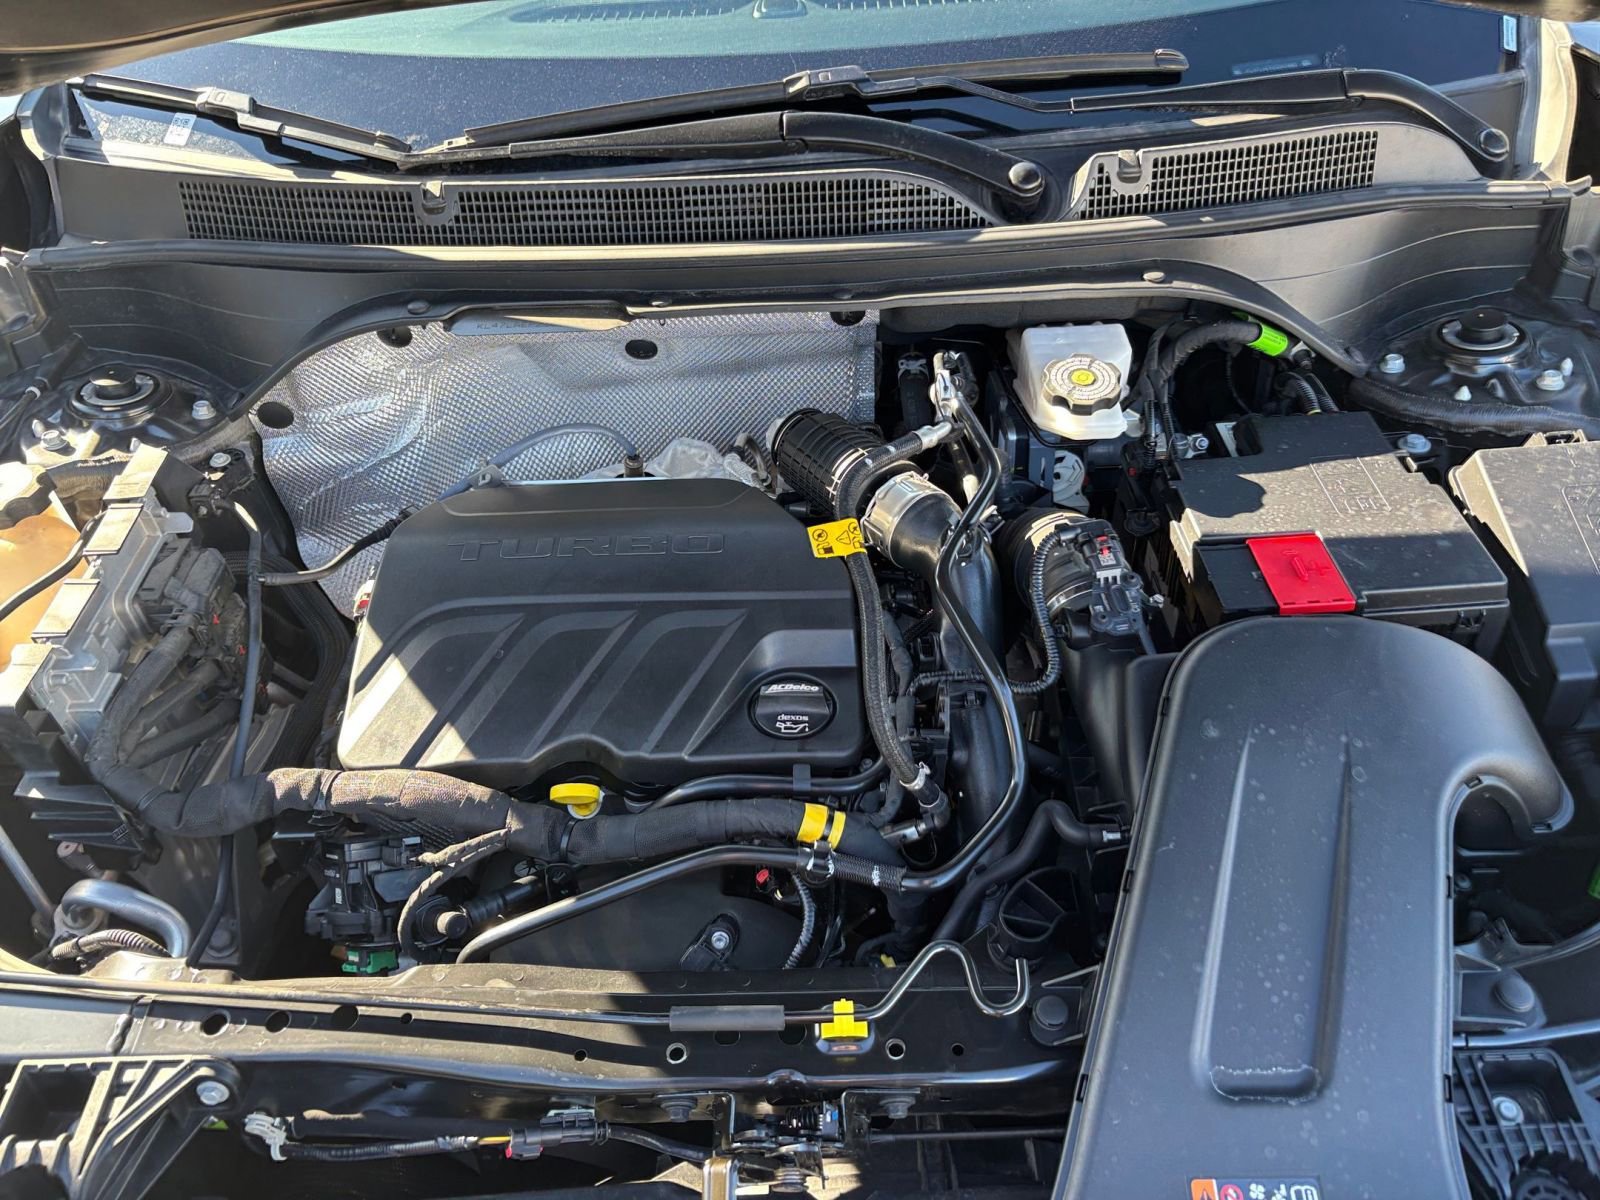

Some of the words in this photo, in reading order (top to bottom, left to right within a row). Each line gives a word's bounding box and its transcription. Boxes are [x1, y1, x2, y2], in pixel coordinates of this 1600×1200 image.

[448, 533, 724, 561] TURBO
[767, 684, 820, 692] ACDelco
[777, 713, 809, 721] dexos
